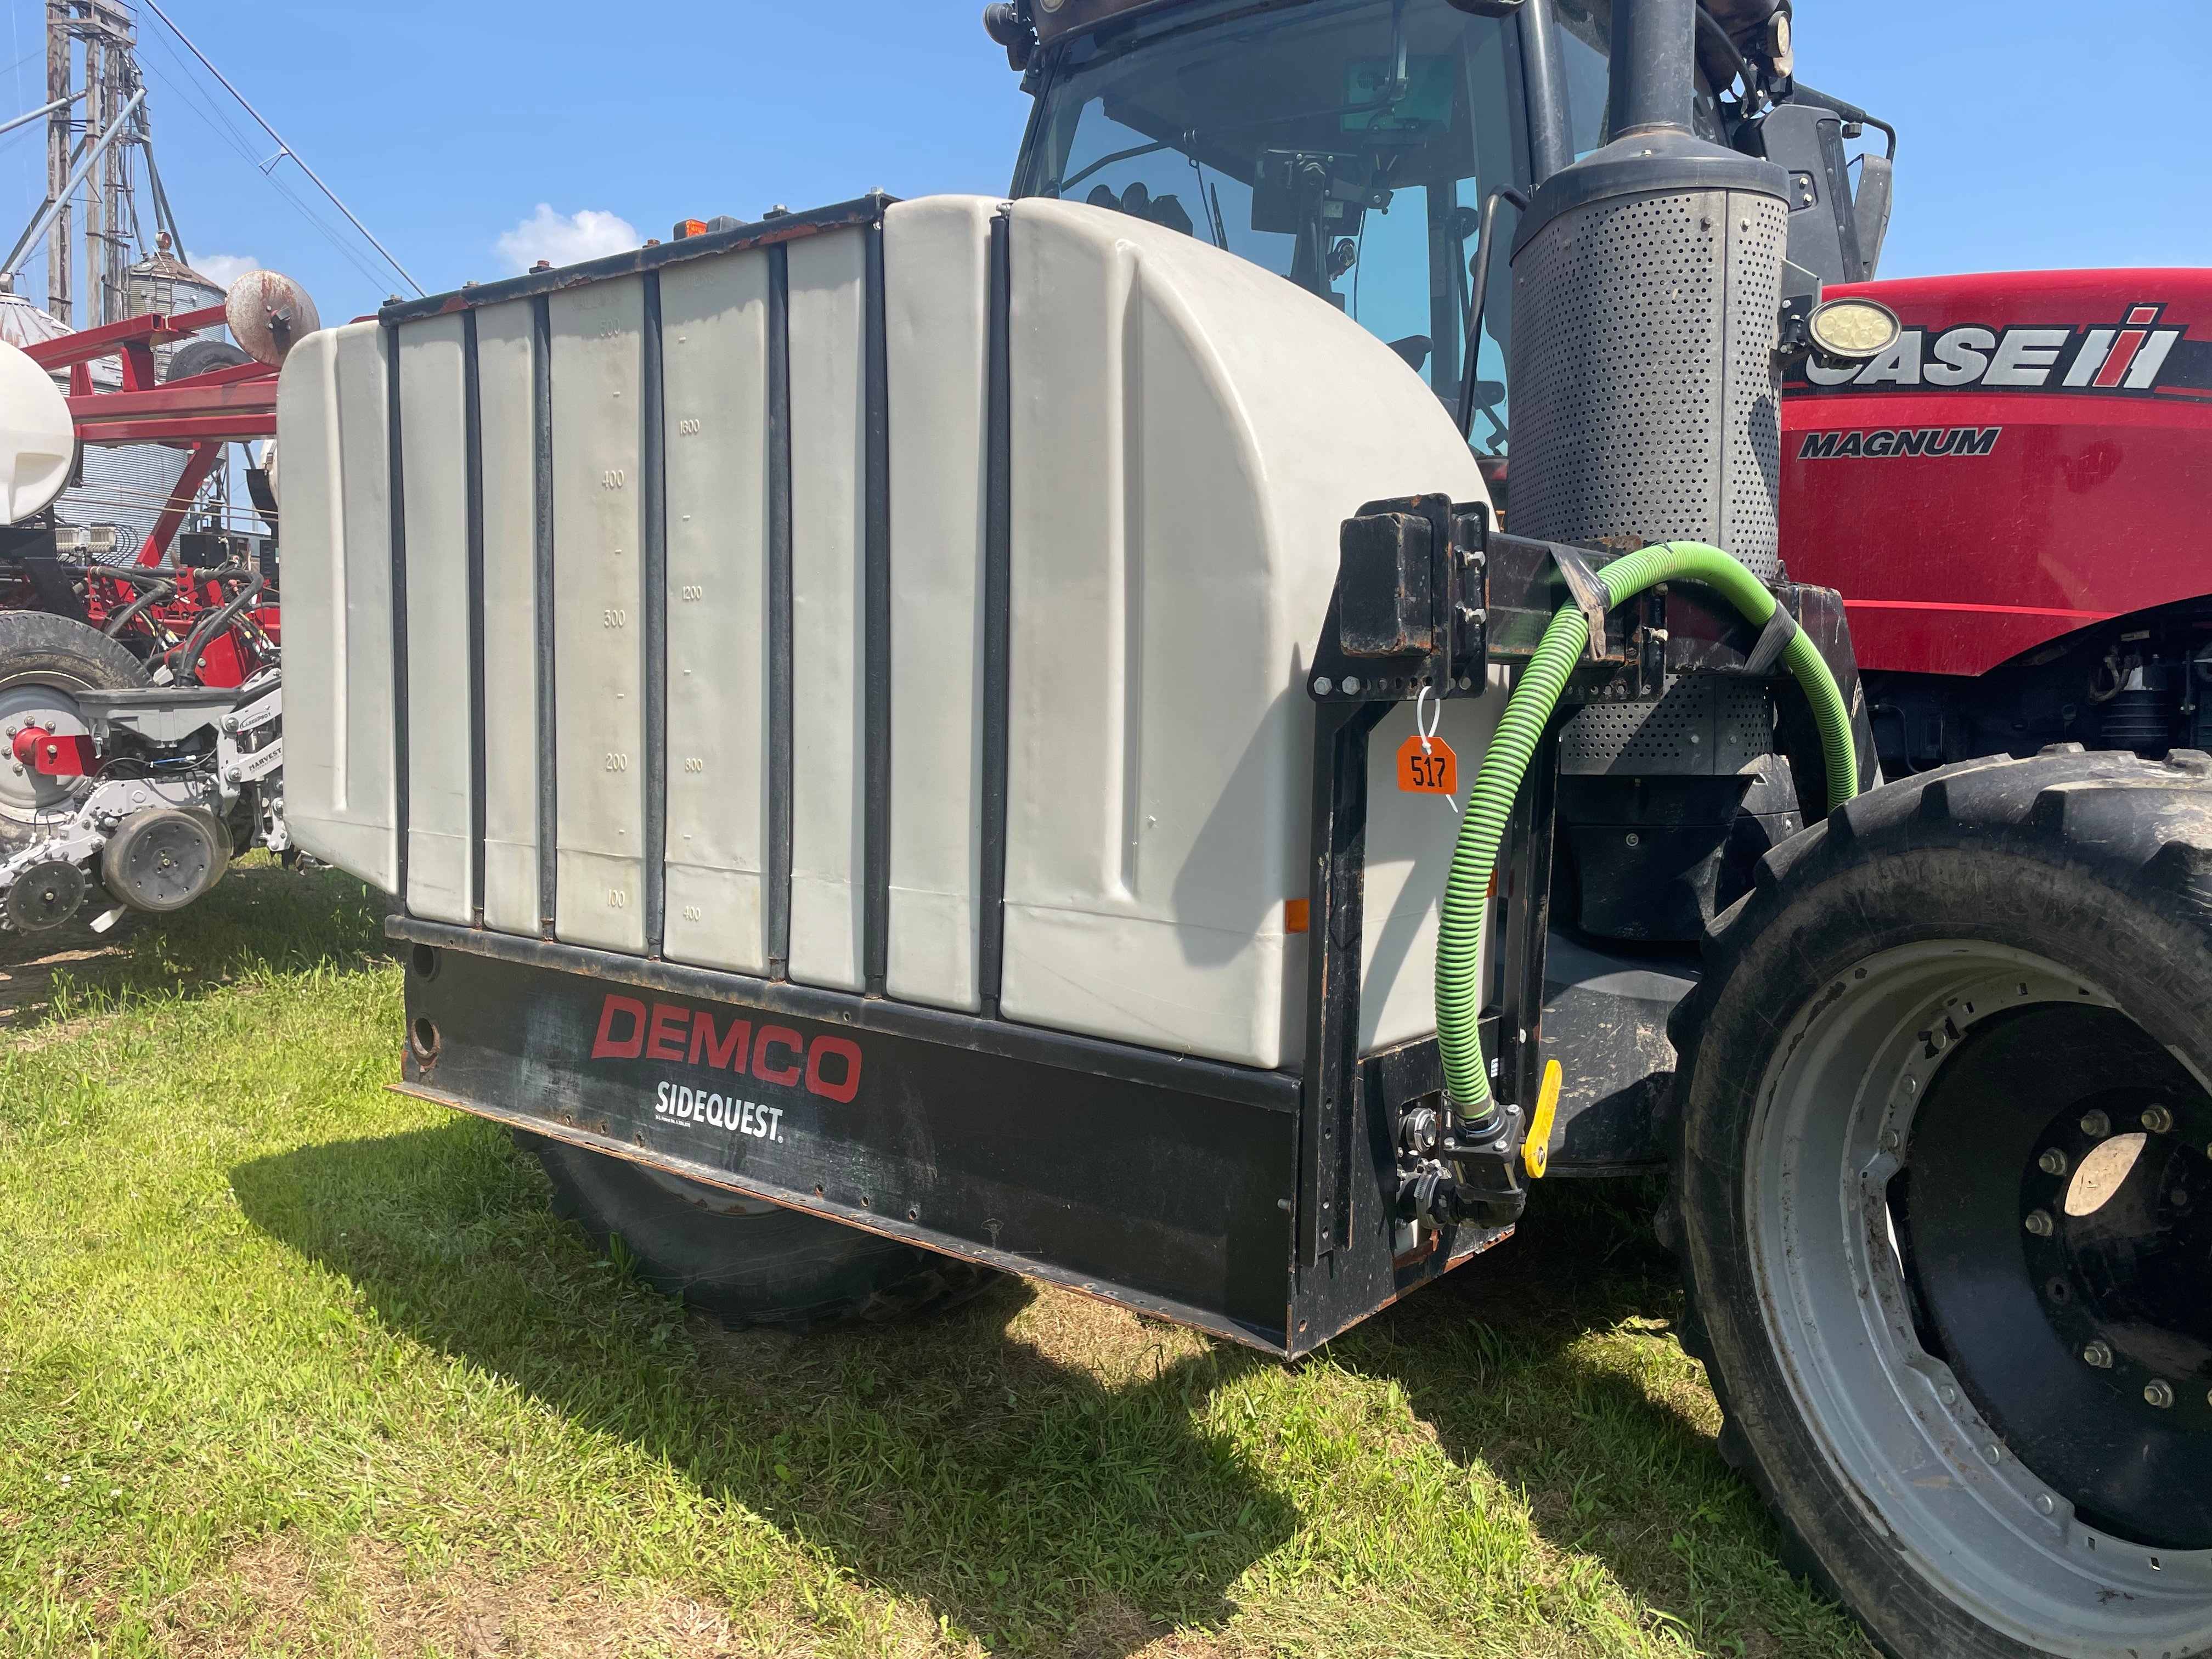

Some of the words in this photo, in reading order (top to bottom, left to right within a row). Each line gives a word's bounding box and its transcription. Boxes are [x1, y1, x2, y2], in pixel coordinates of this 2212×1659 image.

[600, 317, 620, 337] 500
[680, 419, 700, 436] 1600
[1797, 427, 2002, 459] MAGNUM
[602, 469, 625, 488] 400
[682, 585, 702, 601] 1200
[604, 609, 626, 628] 300
[249, 747, 281, 771] HARVEST
[605, 752, 628, 772] 200
[685, 758, 703, 773] 800
[1410, 755, 1446, 788] 517
[607, 888, 626, 908] 100
[684, 905, 702, 921] 400
[591, 994, 862, 1104] DEMCO
